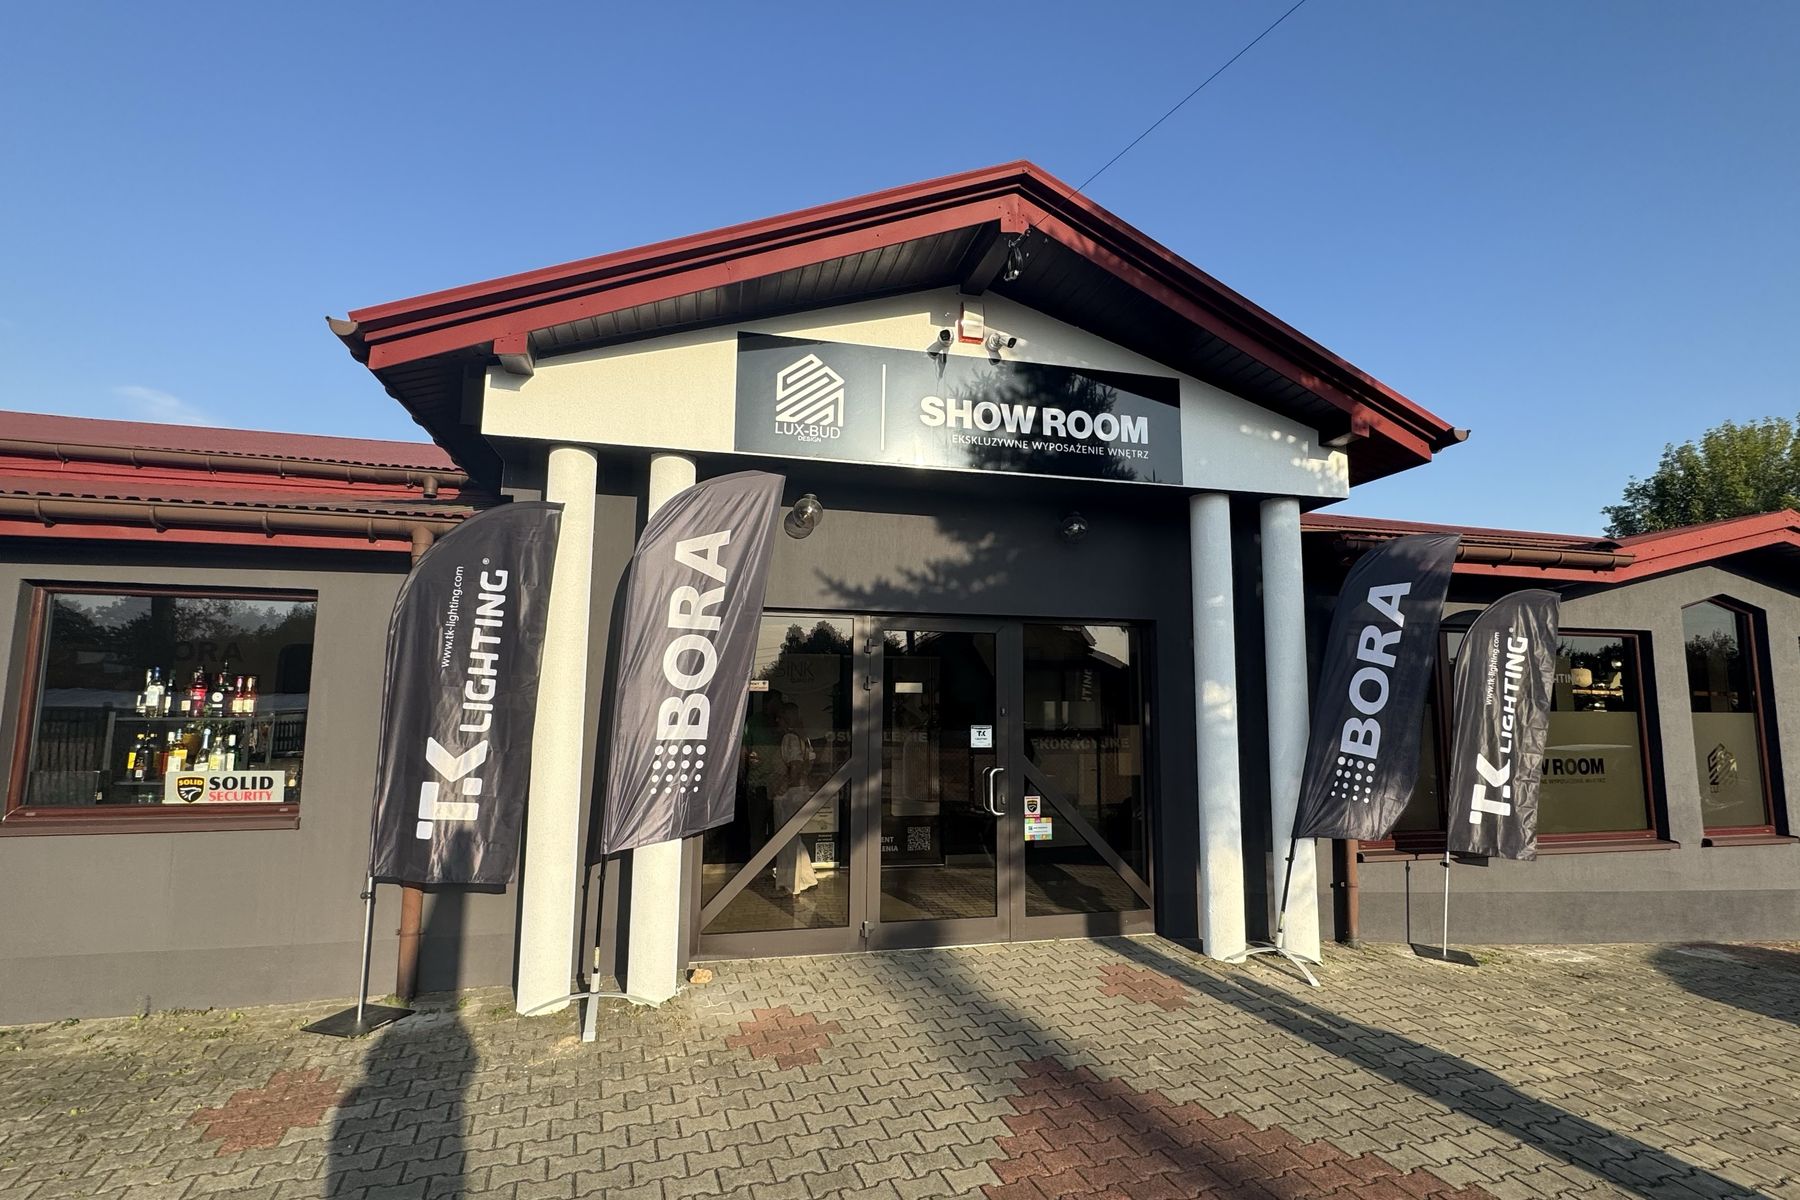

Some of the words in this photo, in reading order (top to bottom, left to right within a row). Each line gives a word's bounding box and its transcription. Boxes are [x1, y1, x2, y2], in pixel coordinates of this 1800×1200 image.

[775, 421, 841, 439] LUX-BUD
[919, 395, 1037, 434] SHOW
[1042, 407, 1149, 444] ROOM
[798, 435, 822, 443] DESIGN
[952, 434, 1029, 450] EKSKLUZYWNE
[1032, 441, 1105, 456] WYPOSAŻENIE
[1108, 447, 1150, 460] WNĘTRZ
[441, 565, 465, 669] www.tk-lighting.com
[656, 529, 732, 741] BORA
[1340, 582, 1412, 759] BORA
[1485, 632, 1501, 706] www.tk-lighting.com
[416, 737, 489, 840] TK
[459, 569, 510, 733] LIGHTING
[1469, 752, 1511, 825] TK
[1499, 636, 1529, 754] LIGHTING
[179, 779, 203, 787] SOLID
[209, 776, 274, 790] SOLID
[1552, 758, 1606, 776] ROOM
[209, 791, 274, 802] SECURITY
